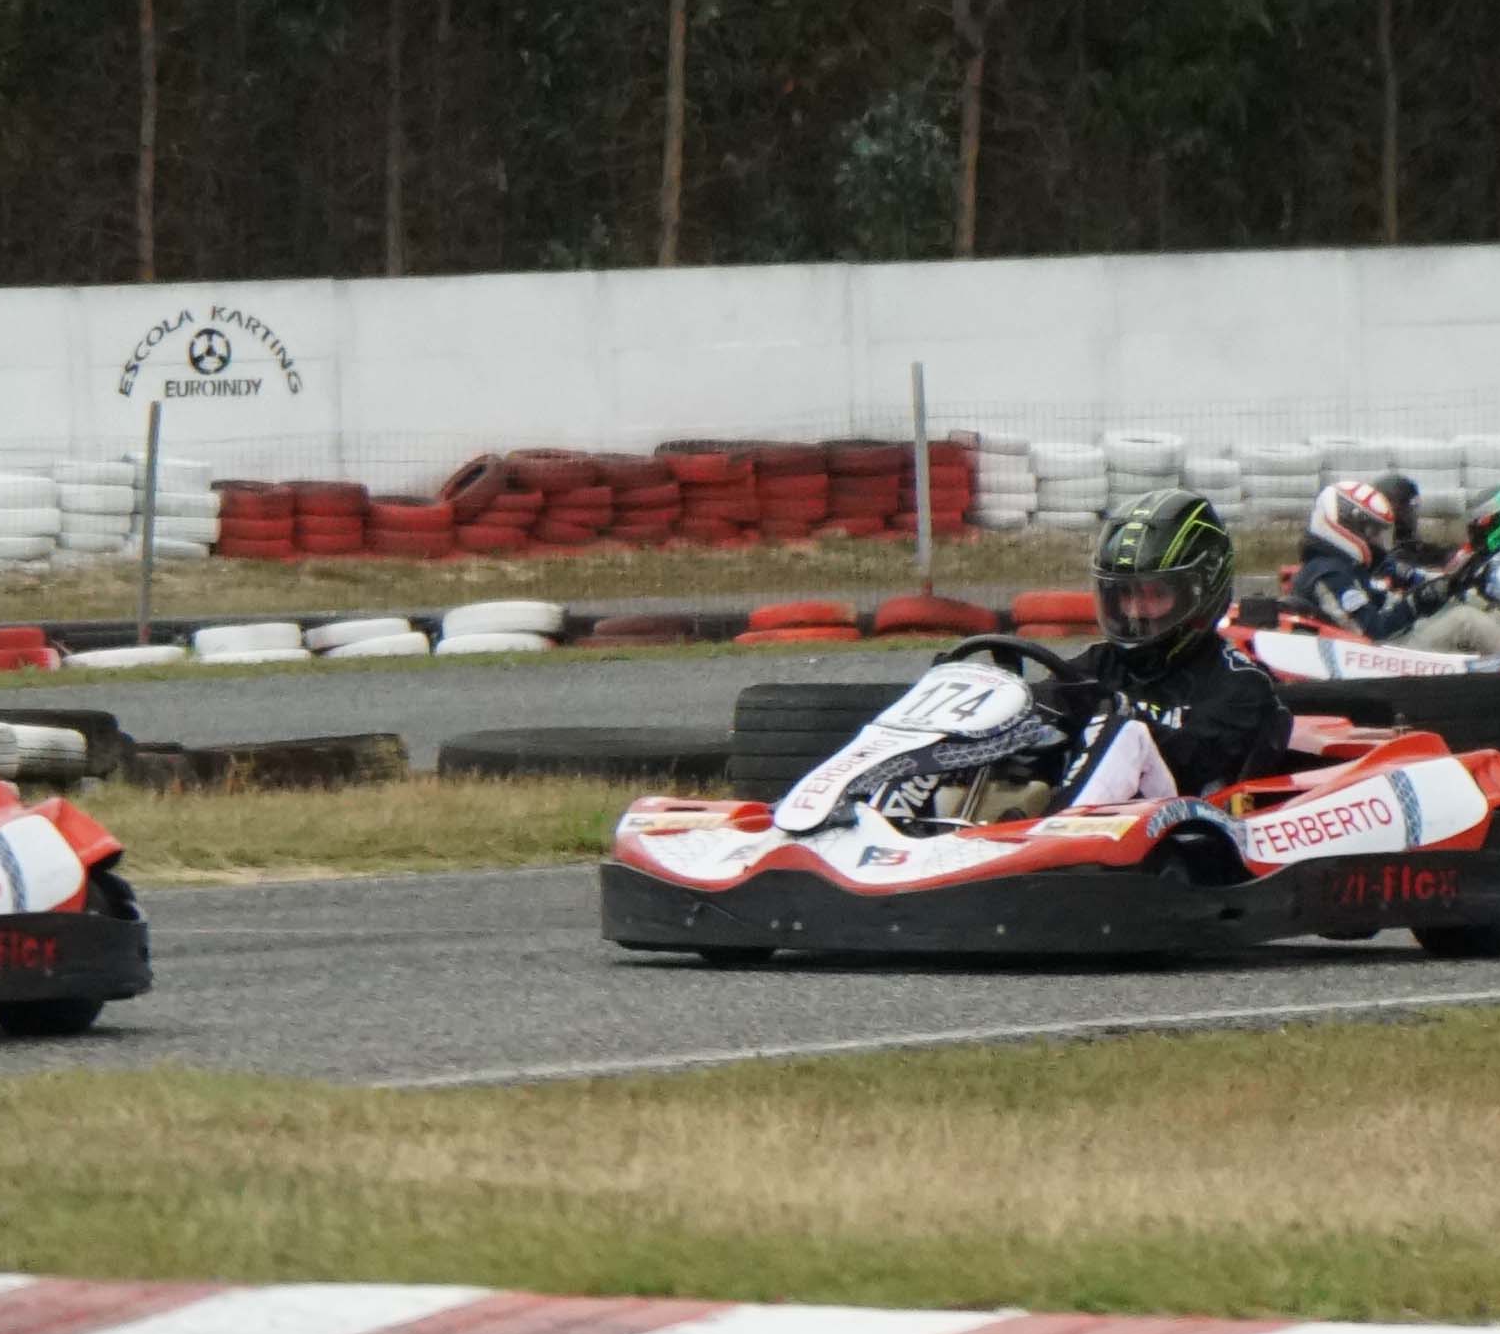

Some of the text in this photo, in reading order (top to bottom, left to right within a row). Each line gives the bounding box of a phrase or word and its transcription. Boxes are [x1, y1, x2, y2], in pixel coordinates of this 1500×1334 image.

[118, 305, 303, 398] ESCOLA KARTING
[164, 378, 263, 398] EUROINDY
[900, 679, 995, 723] 174
[1251, 797, 1393, 858] FERBERTO
